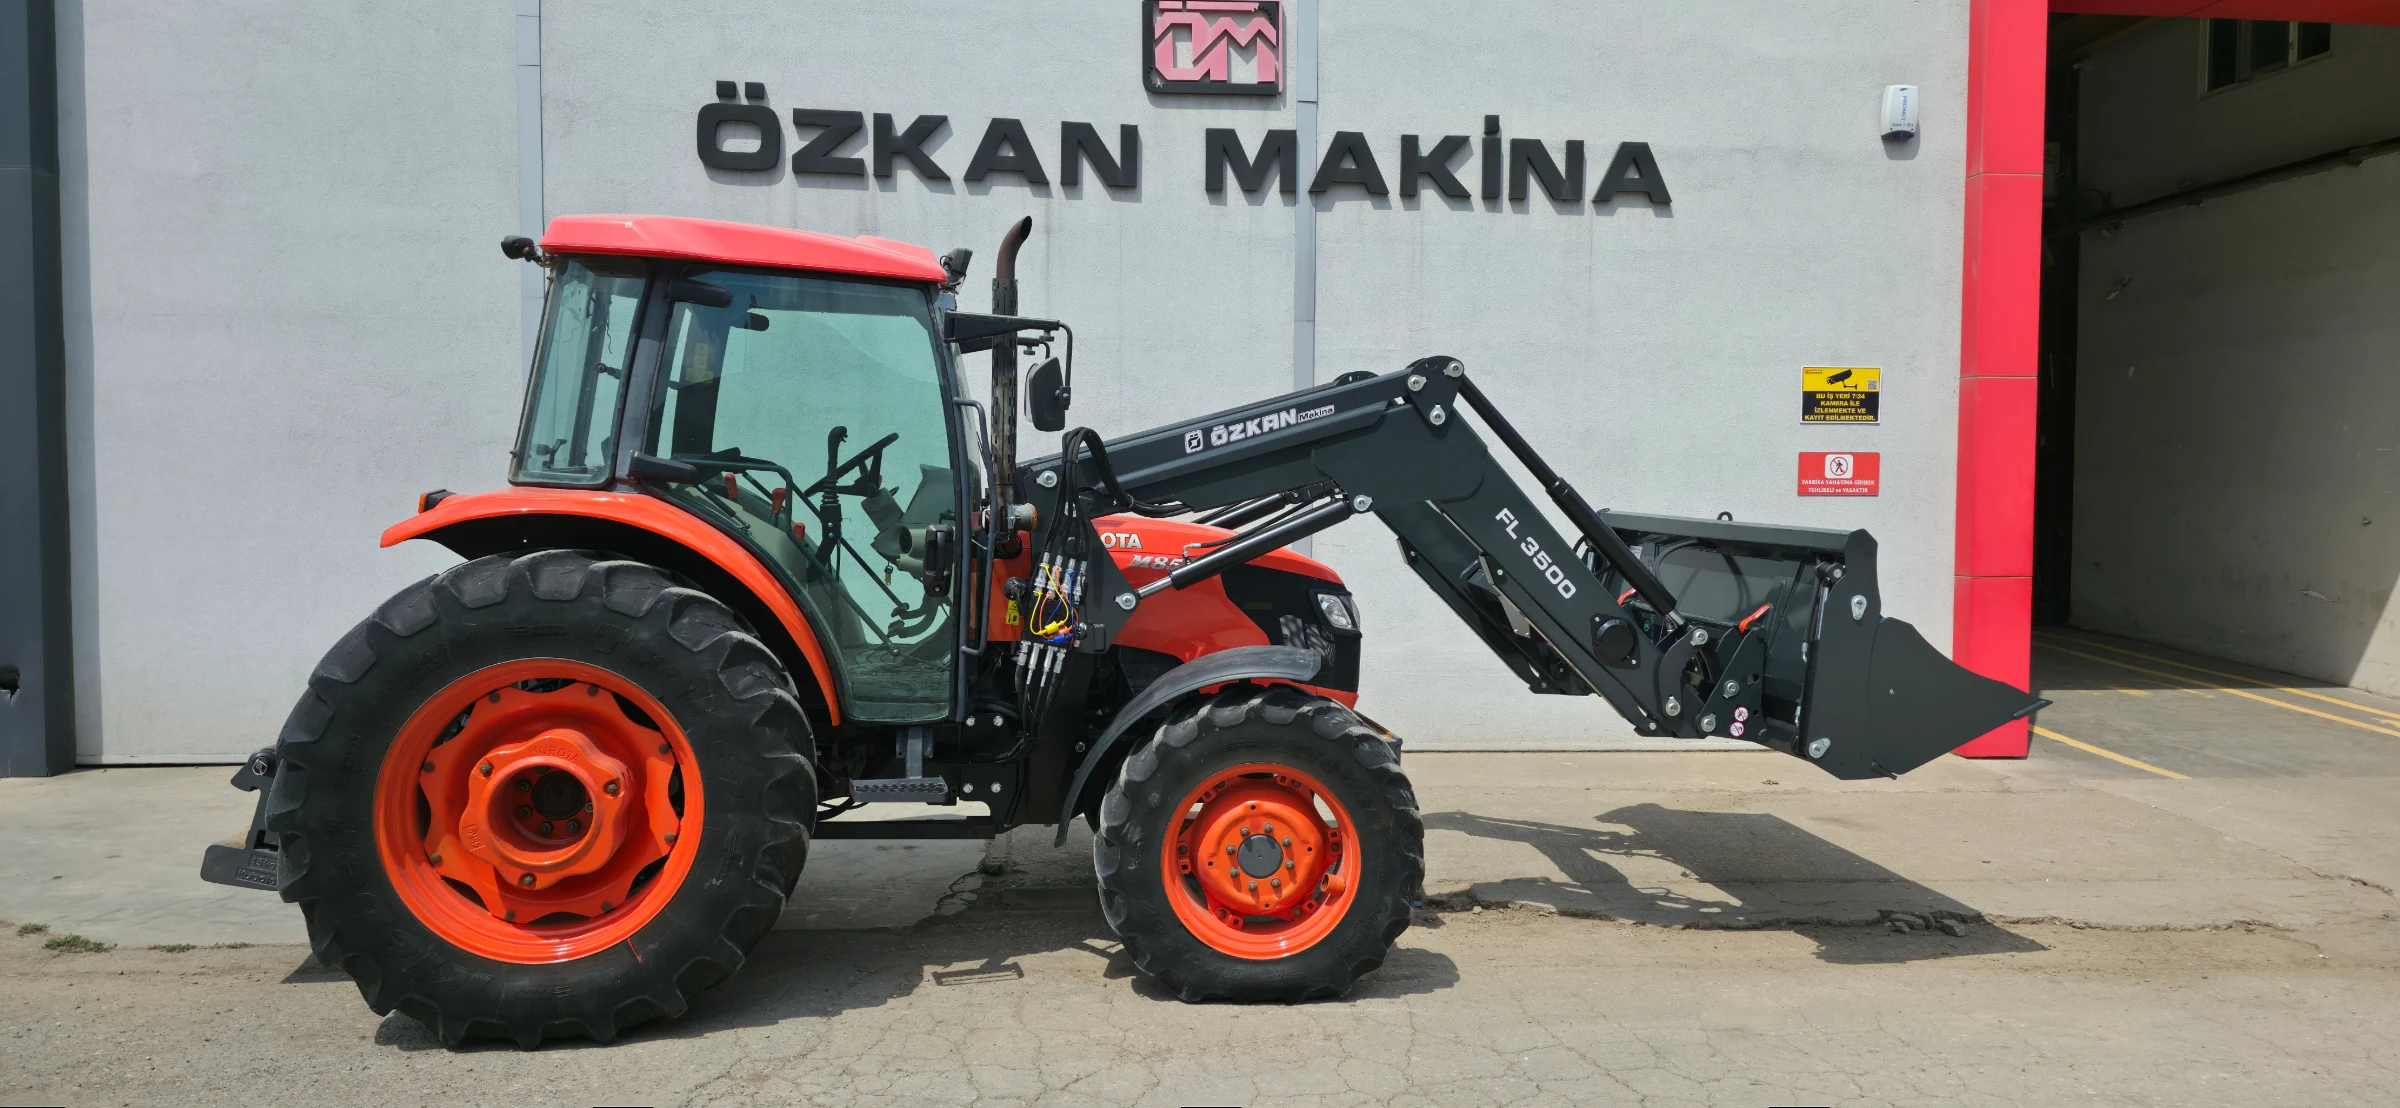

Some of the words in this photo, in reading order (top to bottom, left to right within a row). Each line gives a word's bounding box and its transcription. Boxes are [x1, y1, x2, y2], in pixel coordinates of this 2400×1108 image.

[696, 80, 1139, 188] ÖZKAN
[1205, 114, 1673, 203] MAKİNA
[1210, 408, 1297, 446] ÖZKAN
[1299, 405, 1334, 423] Makina
[1100, 532, 1143, 549] OTA
[1495, 507, 1519, 540] FL
[1520, 536, 1577, 599] 3500
[1127, 554, 1184, 570] M85
